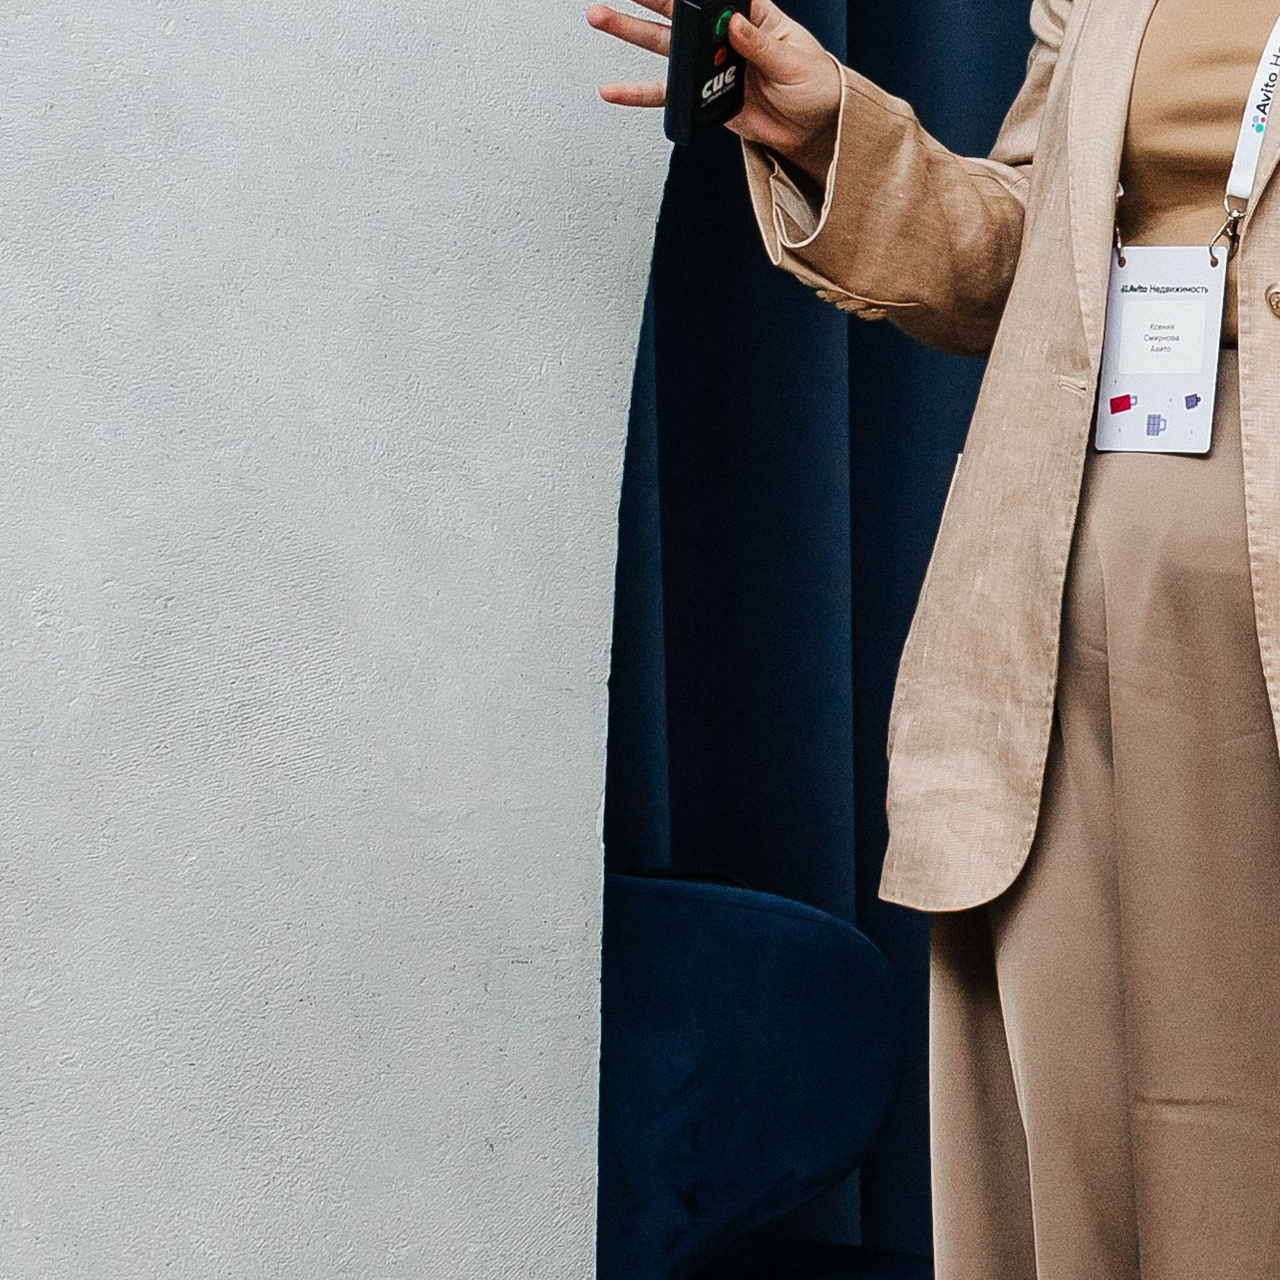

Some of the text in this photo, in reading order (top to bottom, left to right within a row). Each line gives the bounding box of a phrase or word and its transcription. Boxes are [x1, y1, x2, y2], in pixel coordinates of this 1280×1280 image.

[702, 65, 737, 99] cue
[1256, 72, 1278, 116] Avito
[1149, 284, 1209, 294] Недвижимость
